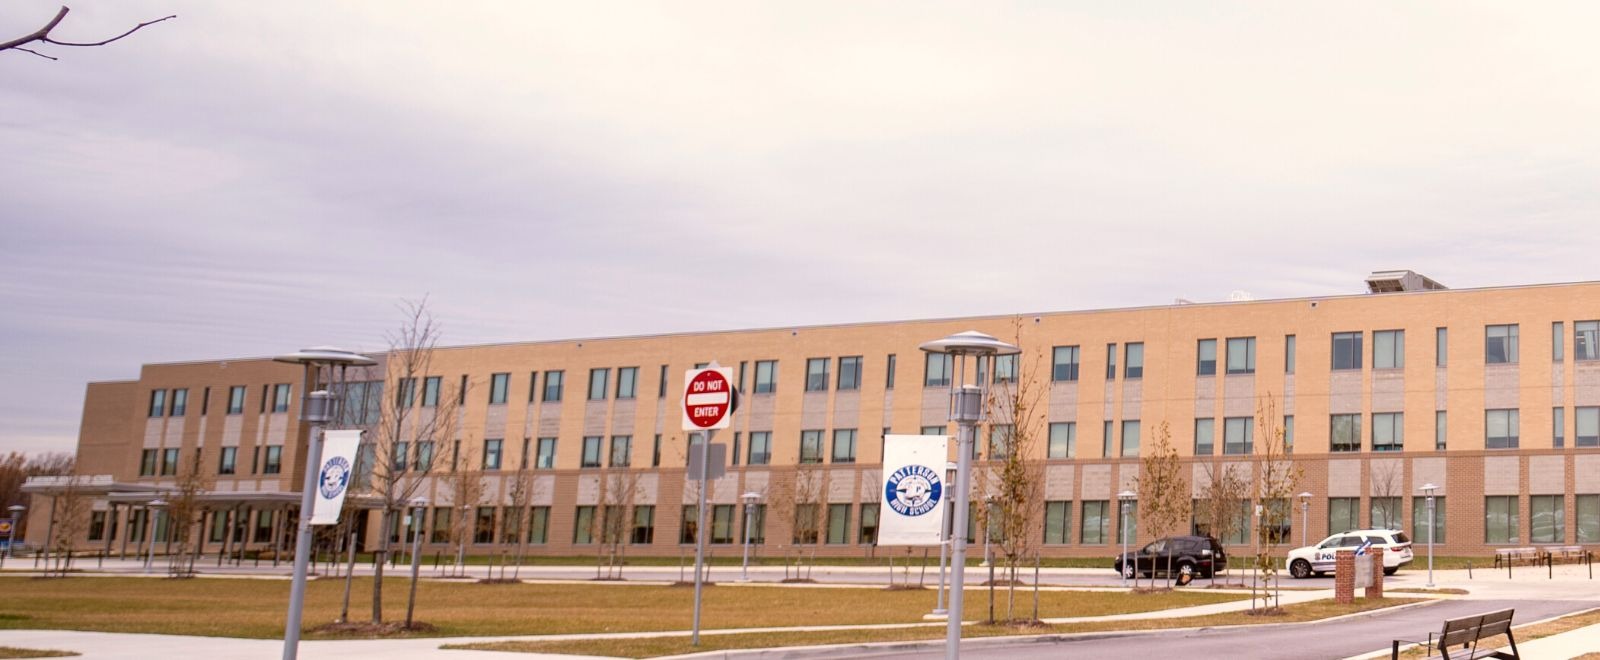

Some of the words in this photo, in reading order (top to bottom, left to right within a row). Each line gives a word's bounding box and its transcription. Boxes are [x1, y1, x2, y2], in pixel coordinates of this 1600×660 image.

[693, 381, 705, 392] DO
[707, 379, 723, 391] NOT
[694, 406, 719, 418] ENTER
[889, 465, 940, 484] PATTERSON
[890, 499, 908, 515] HIGH
[909, 499, 937, 516] SCHOOL
